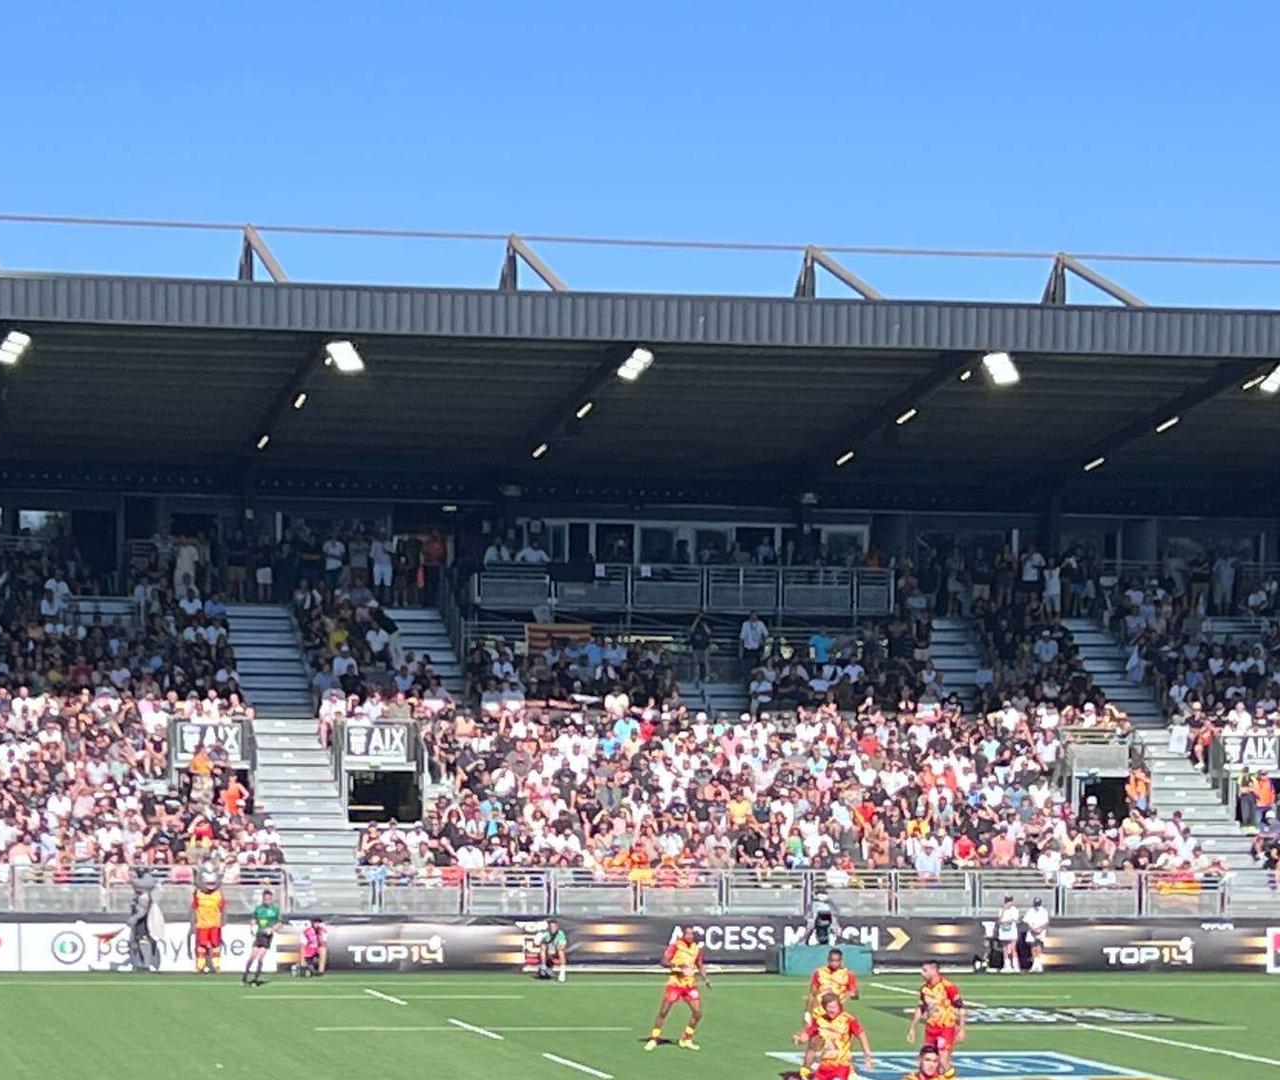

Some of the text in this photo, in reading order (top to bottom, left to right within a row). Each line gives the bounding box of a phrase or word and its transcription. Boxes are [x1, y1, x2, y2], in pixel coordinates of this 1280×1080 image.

[369, 727, 405, 755] AIX
[1243, 737, 1276, 763] AIX
[783, 925, 879, 951] MCH
